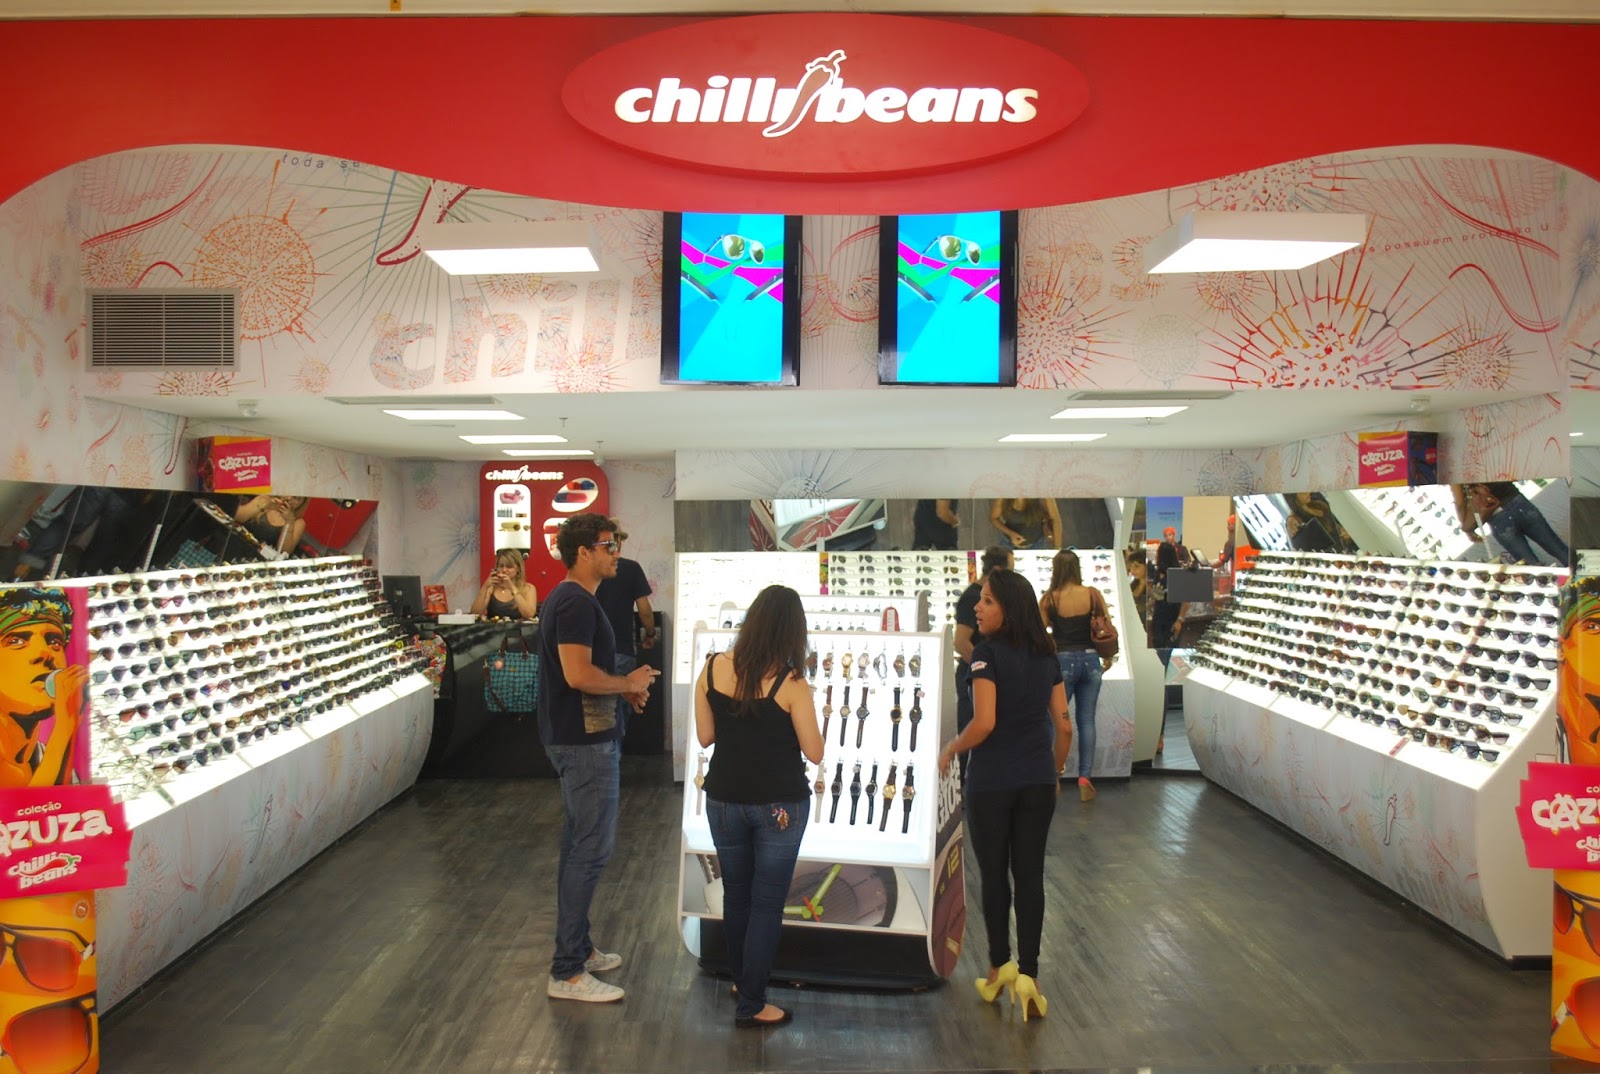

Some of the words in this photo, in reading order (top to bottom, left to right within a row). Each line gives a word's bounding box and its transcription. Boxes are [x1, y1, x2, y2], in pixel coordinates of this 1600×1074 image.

[814, 76, 1040, 124] beans
[282, 153, 324, 169] toda
[1384, 236, 1452, 252] possuem
[17, 801, 62, 817] coleção
[8, 851, 58, 876] chilli
[19, 863, 78, 889] beans
